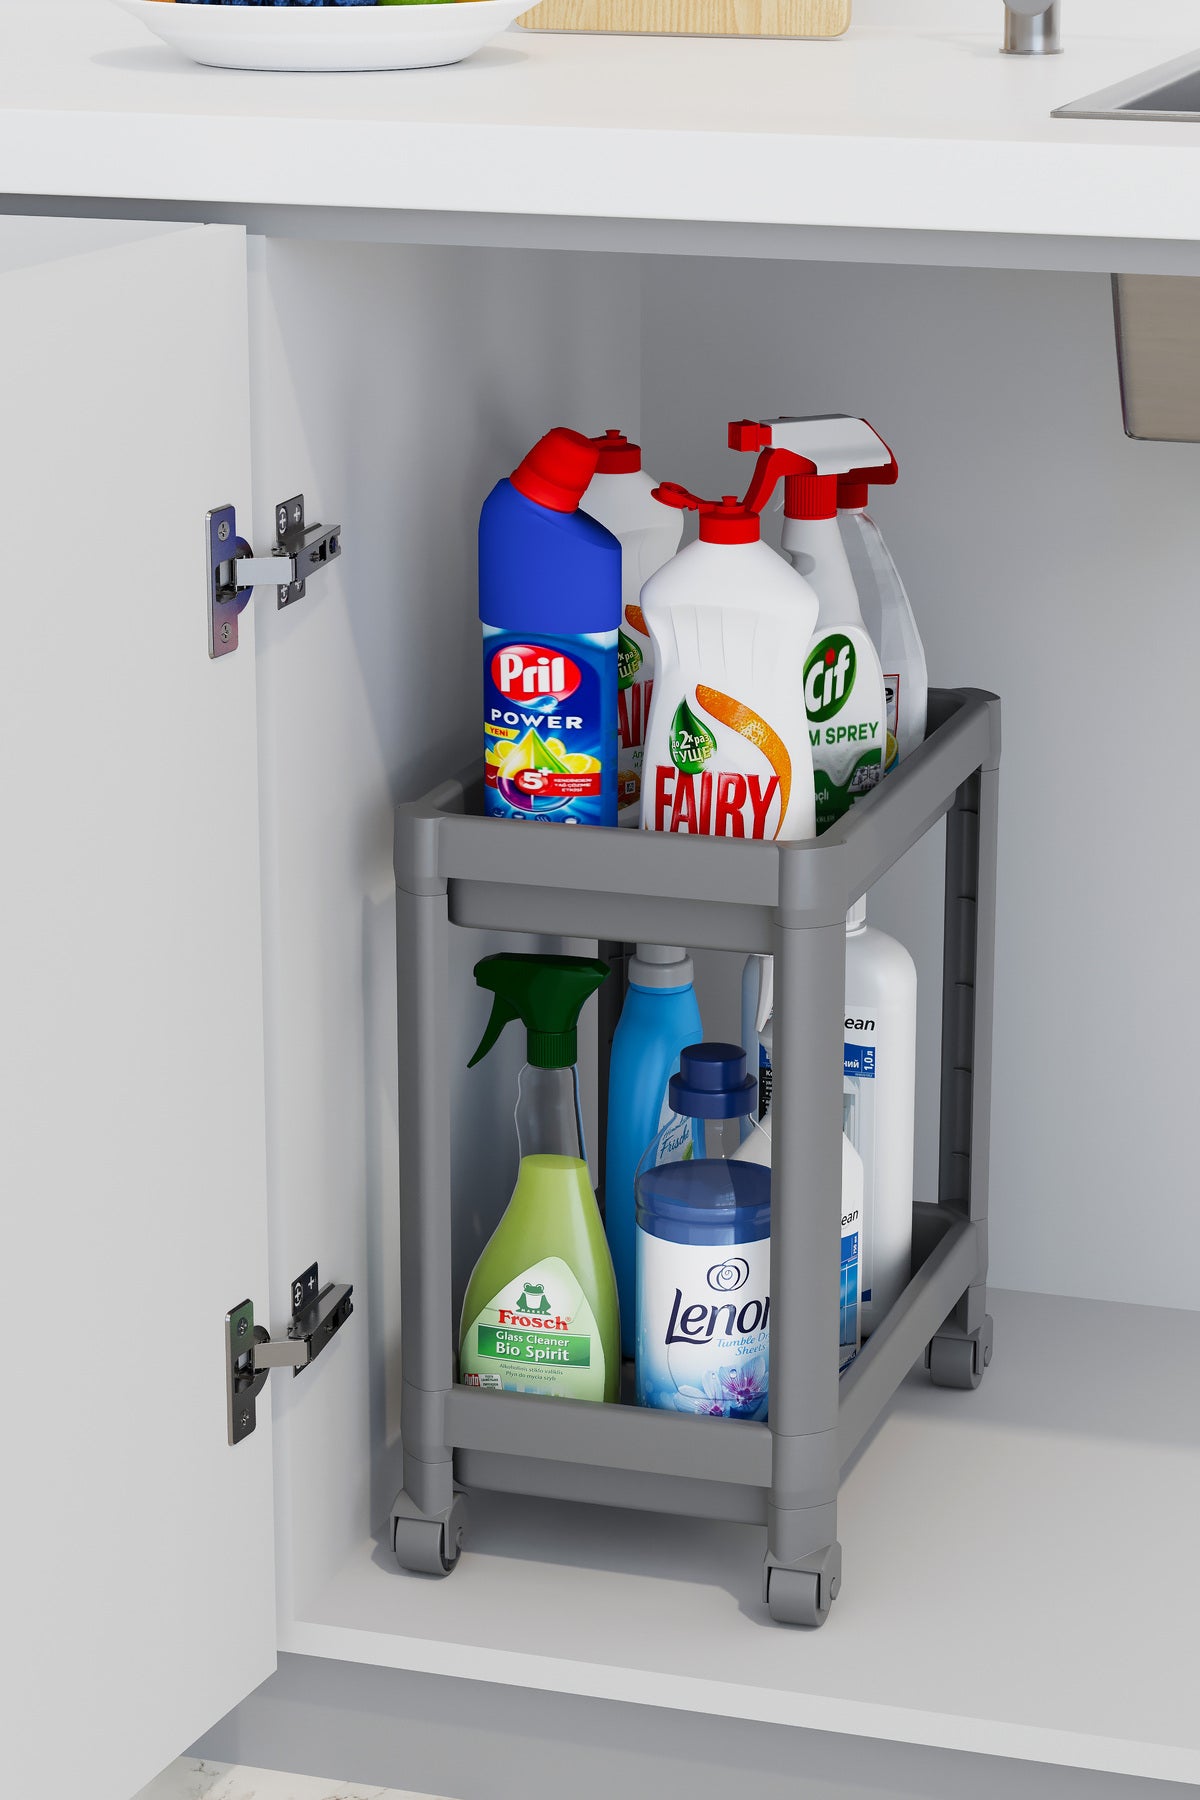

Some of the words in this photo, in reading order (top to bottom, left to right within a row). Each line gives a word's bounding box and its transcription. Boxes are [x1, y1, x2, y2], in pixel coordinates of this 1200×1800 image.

[500, 653, 565, 693] Pril
[804, 645, 850, 713] Cif
[491, 708, 583, 729] POWER
[825, 721, 879, 745] SPREY
[655, 764, 781, 840] FAIRY
[498, 1309, 568, 1331] Frosch
[496, 1331, 523, 1342] Glass
[526, 1335, 570, 1347] Cleaner
[717, 1335, 756, 1348] Tumble
[496, 1342, 520, 1356] Bio
[526, 1346, 570, 1361] Spirit
[736, 1344, 767, 1357] Sheets
